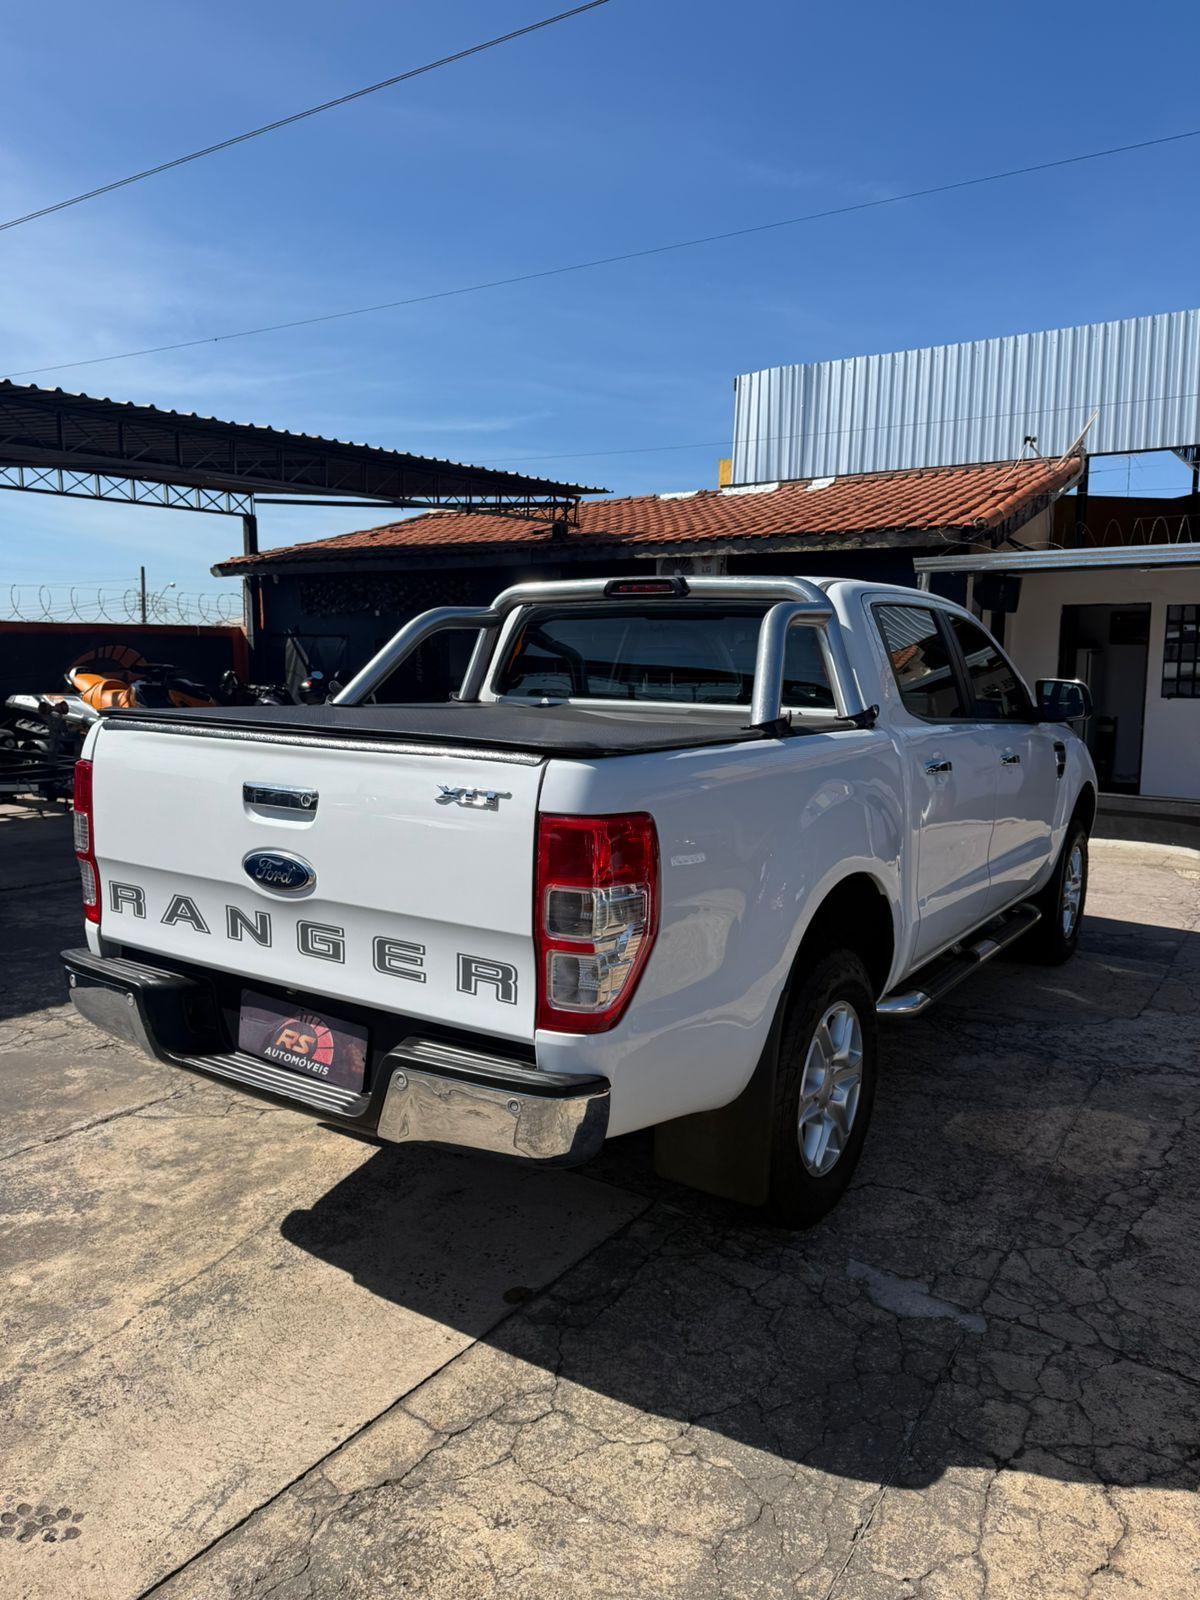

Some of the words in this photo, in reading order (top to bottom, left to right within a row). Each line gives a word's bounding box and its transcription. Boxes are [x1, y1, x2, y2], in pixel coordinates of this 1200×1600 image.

[434, 785, 512, 812] XLT
[255, 858, 294, 884] Ford
[109, 880, 518, 1005] RANGER
[275, 1028, 316, 1054] RS
[264, 1046, 329, 1076] AUTOMÓVEIS
